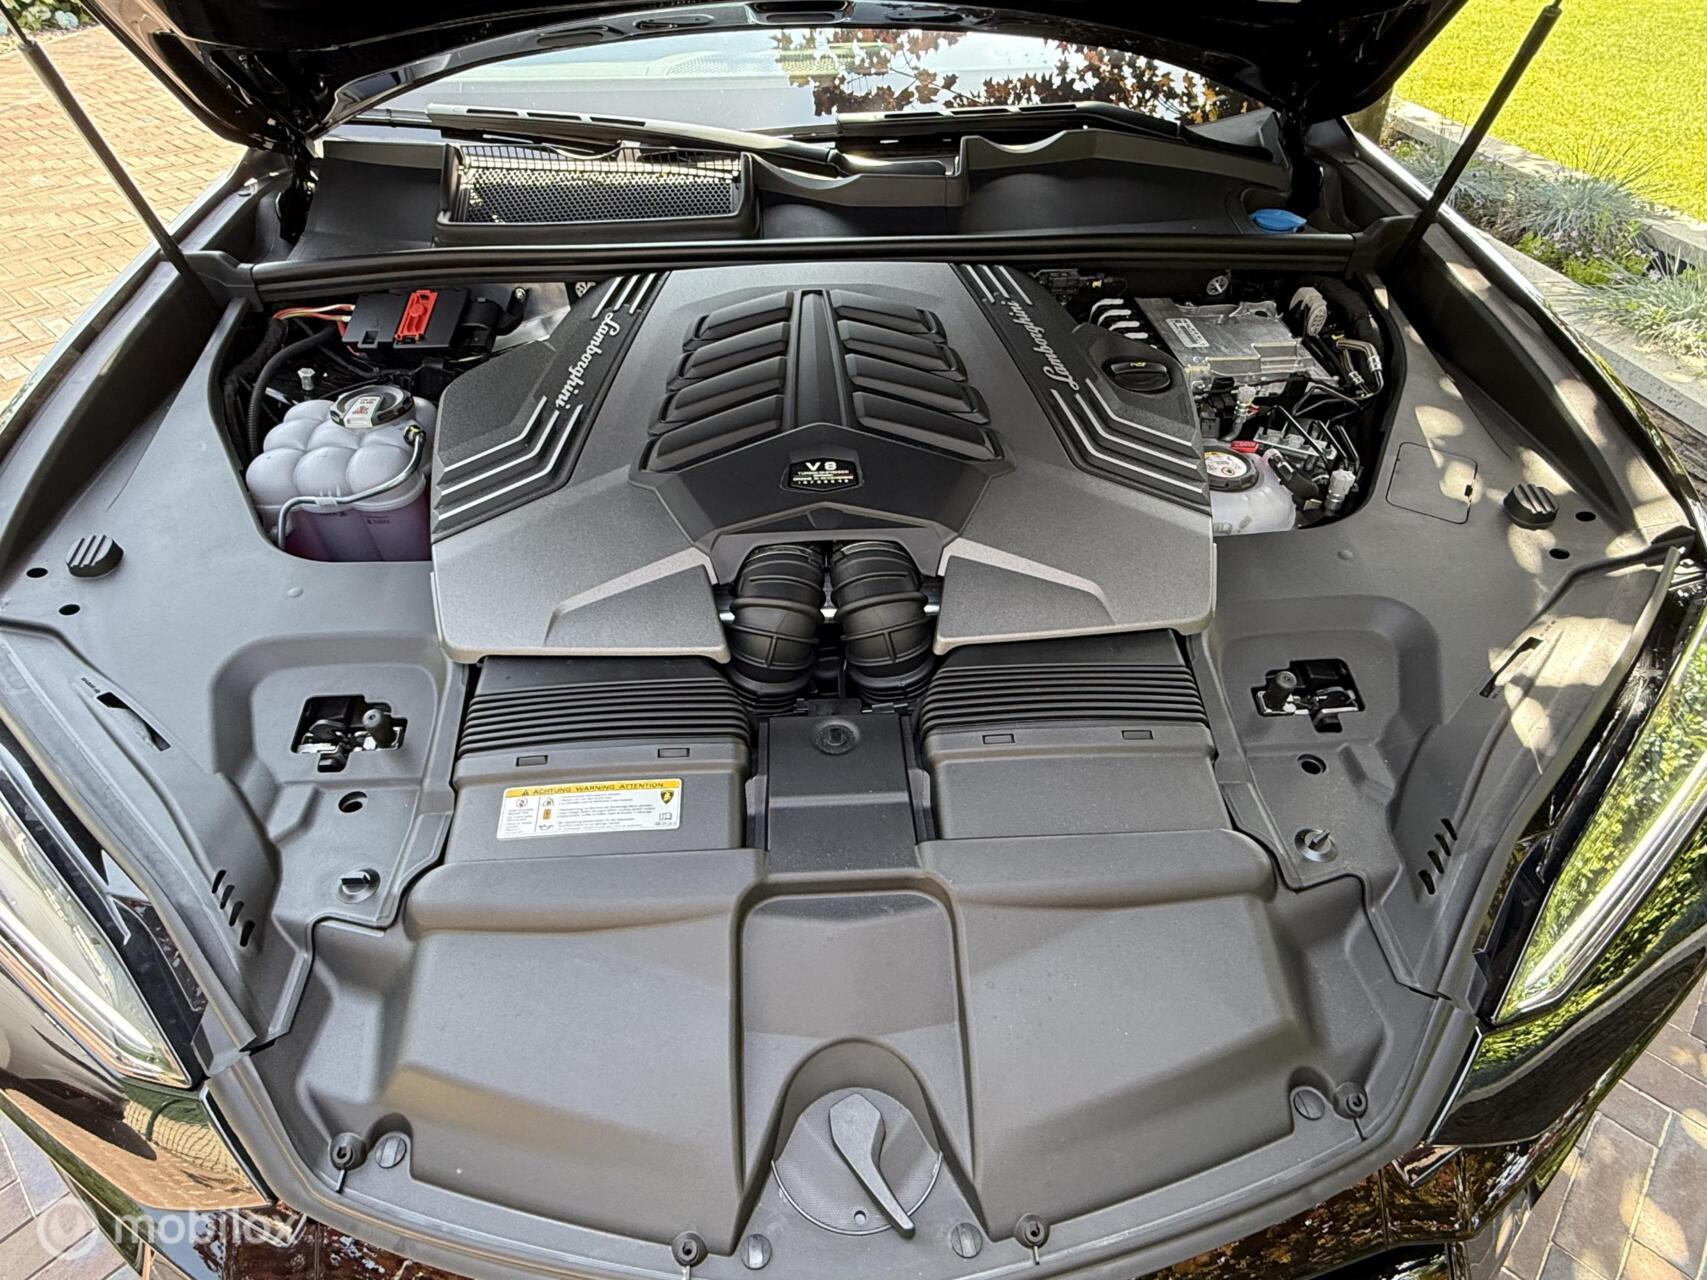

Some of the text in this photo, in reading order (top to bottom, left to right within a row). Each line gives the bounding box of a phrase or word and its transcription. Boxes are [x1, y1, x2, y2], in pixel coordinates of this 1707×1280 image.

[554, 312, 621, 410] Lamborghini
[1000, 300, 1080, 391] Lamborghini
[533, 782, 664, 795] ACHTUNG WARNING ATTENTION
